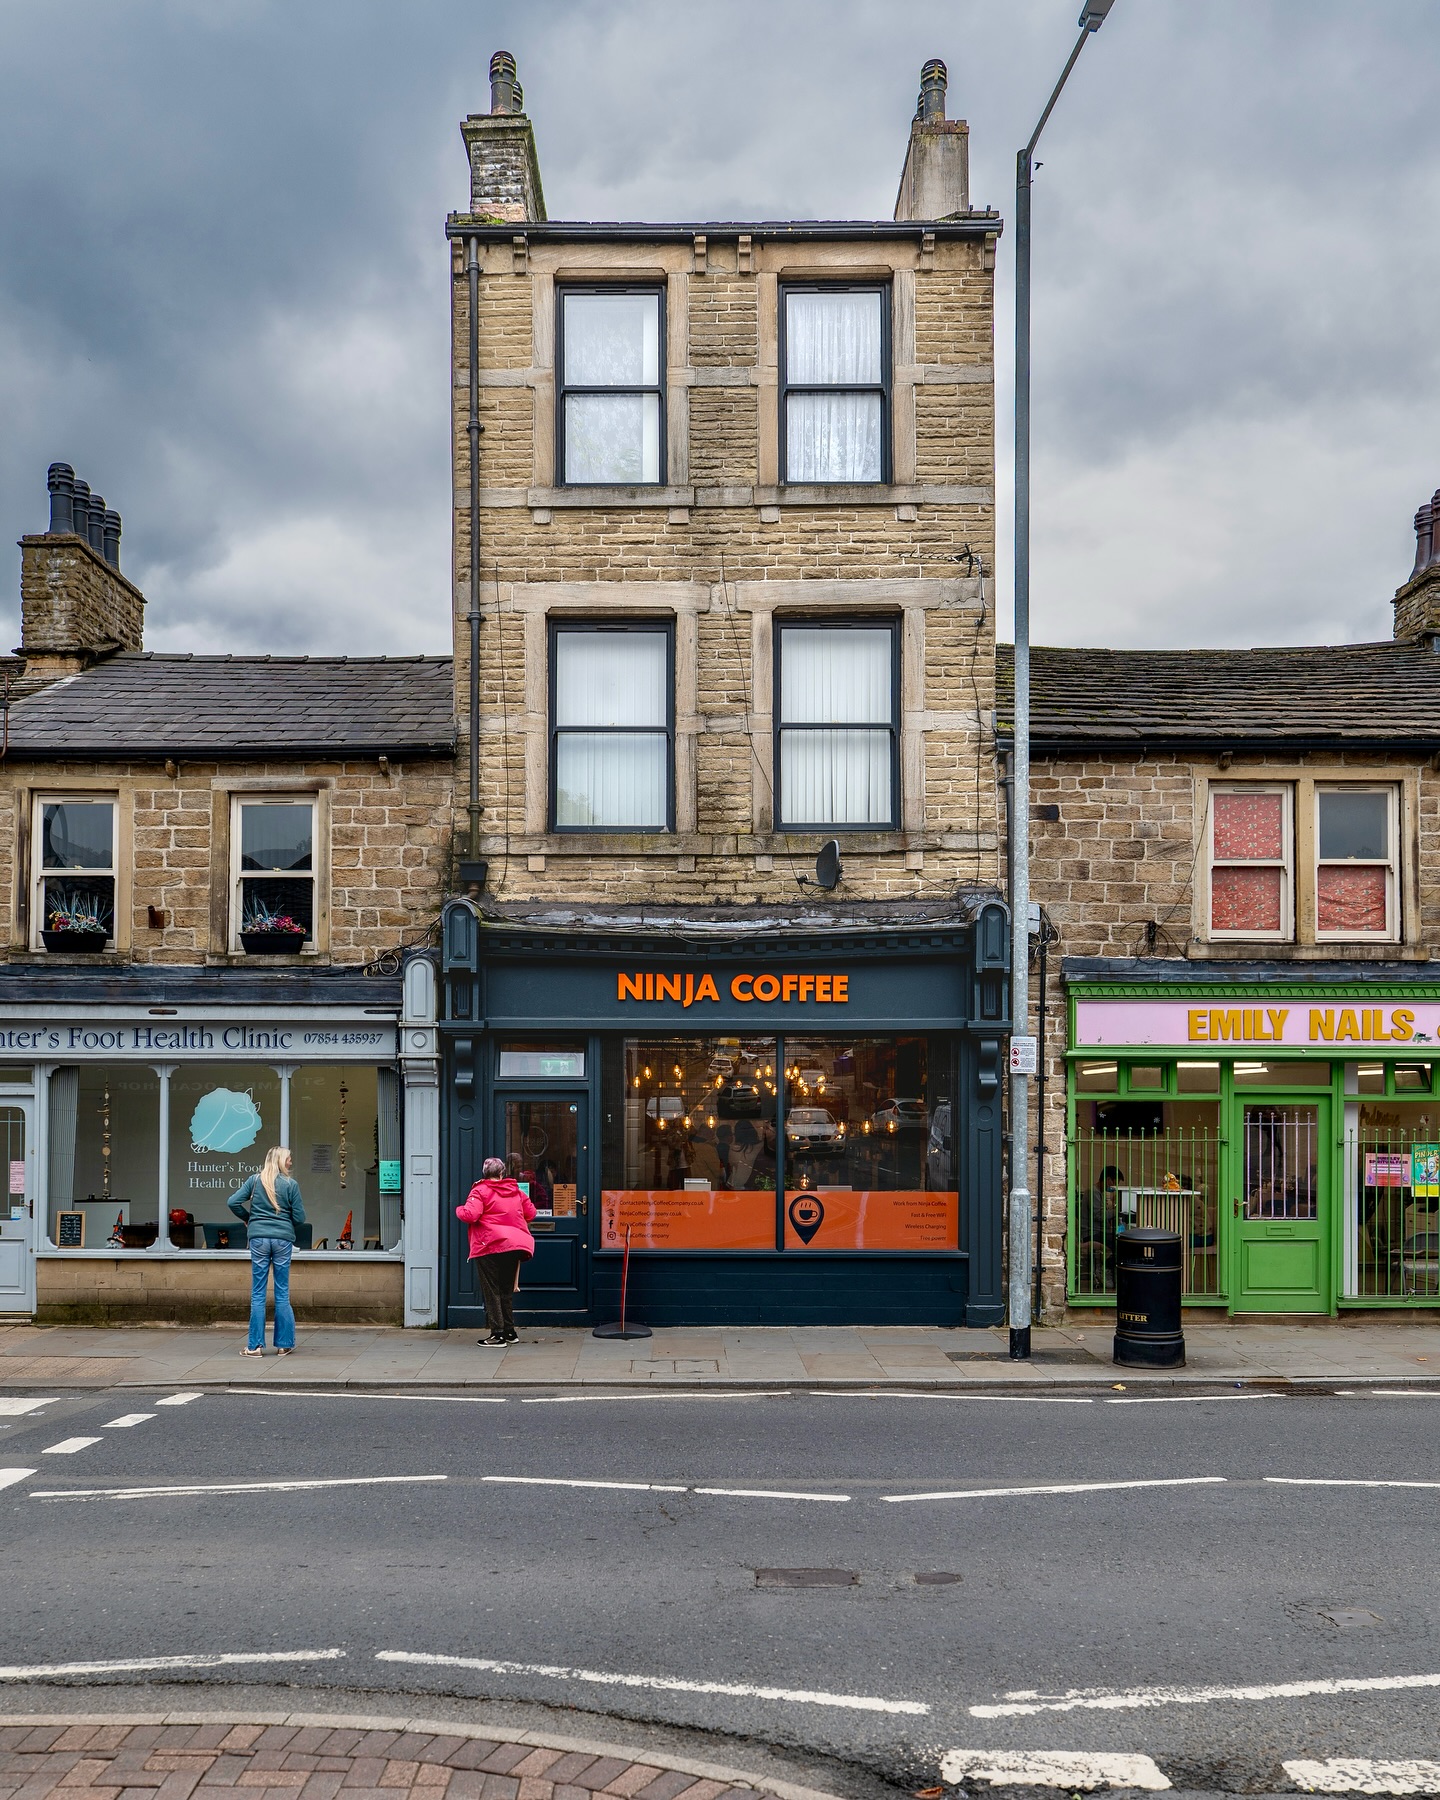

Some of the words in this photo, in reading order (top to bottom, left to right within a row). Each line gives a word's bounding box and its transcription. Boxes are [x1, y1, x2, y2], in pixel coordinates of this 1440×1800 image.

[617, 973, 720, 1008] NINJA
[730, 974, 849, 1002] COFFEE
[1188, 1009, 1289, 1040] EMILY
[1309, 1009, 1415, 1040] NAILS
[67, 1027, 126, 1049] Foot
[132, 1026, 214, 1049] Health
[222, 1026, 293, 1049] Clinic
[303, 1032, 339, 1045] 07854
[341, 1032, 384, 1045] 435937
[187, 1161, 235, 1173] Hunter's
[238, 1161, 263, 1173] Foot
[189, 1178, 226, 1189] Health
[229, 1178, 245, 1189] Cli
